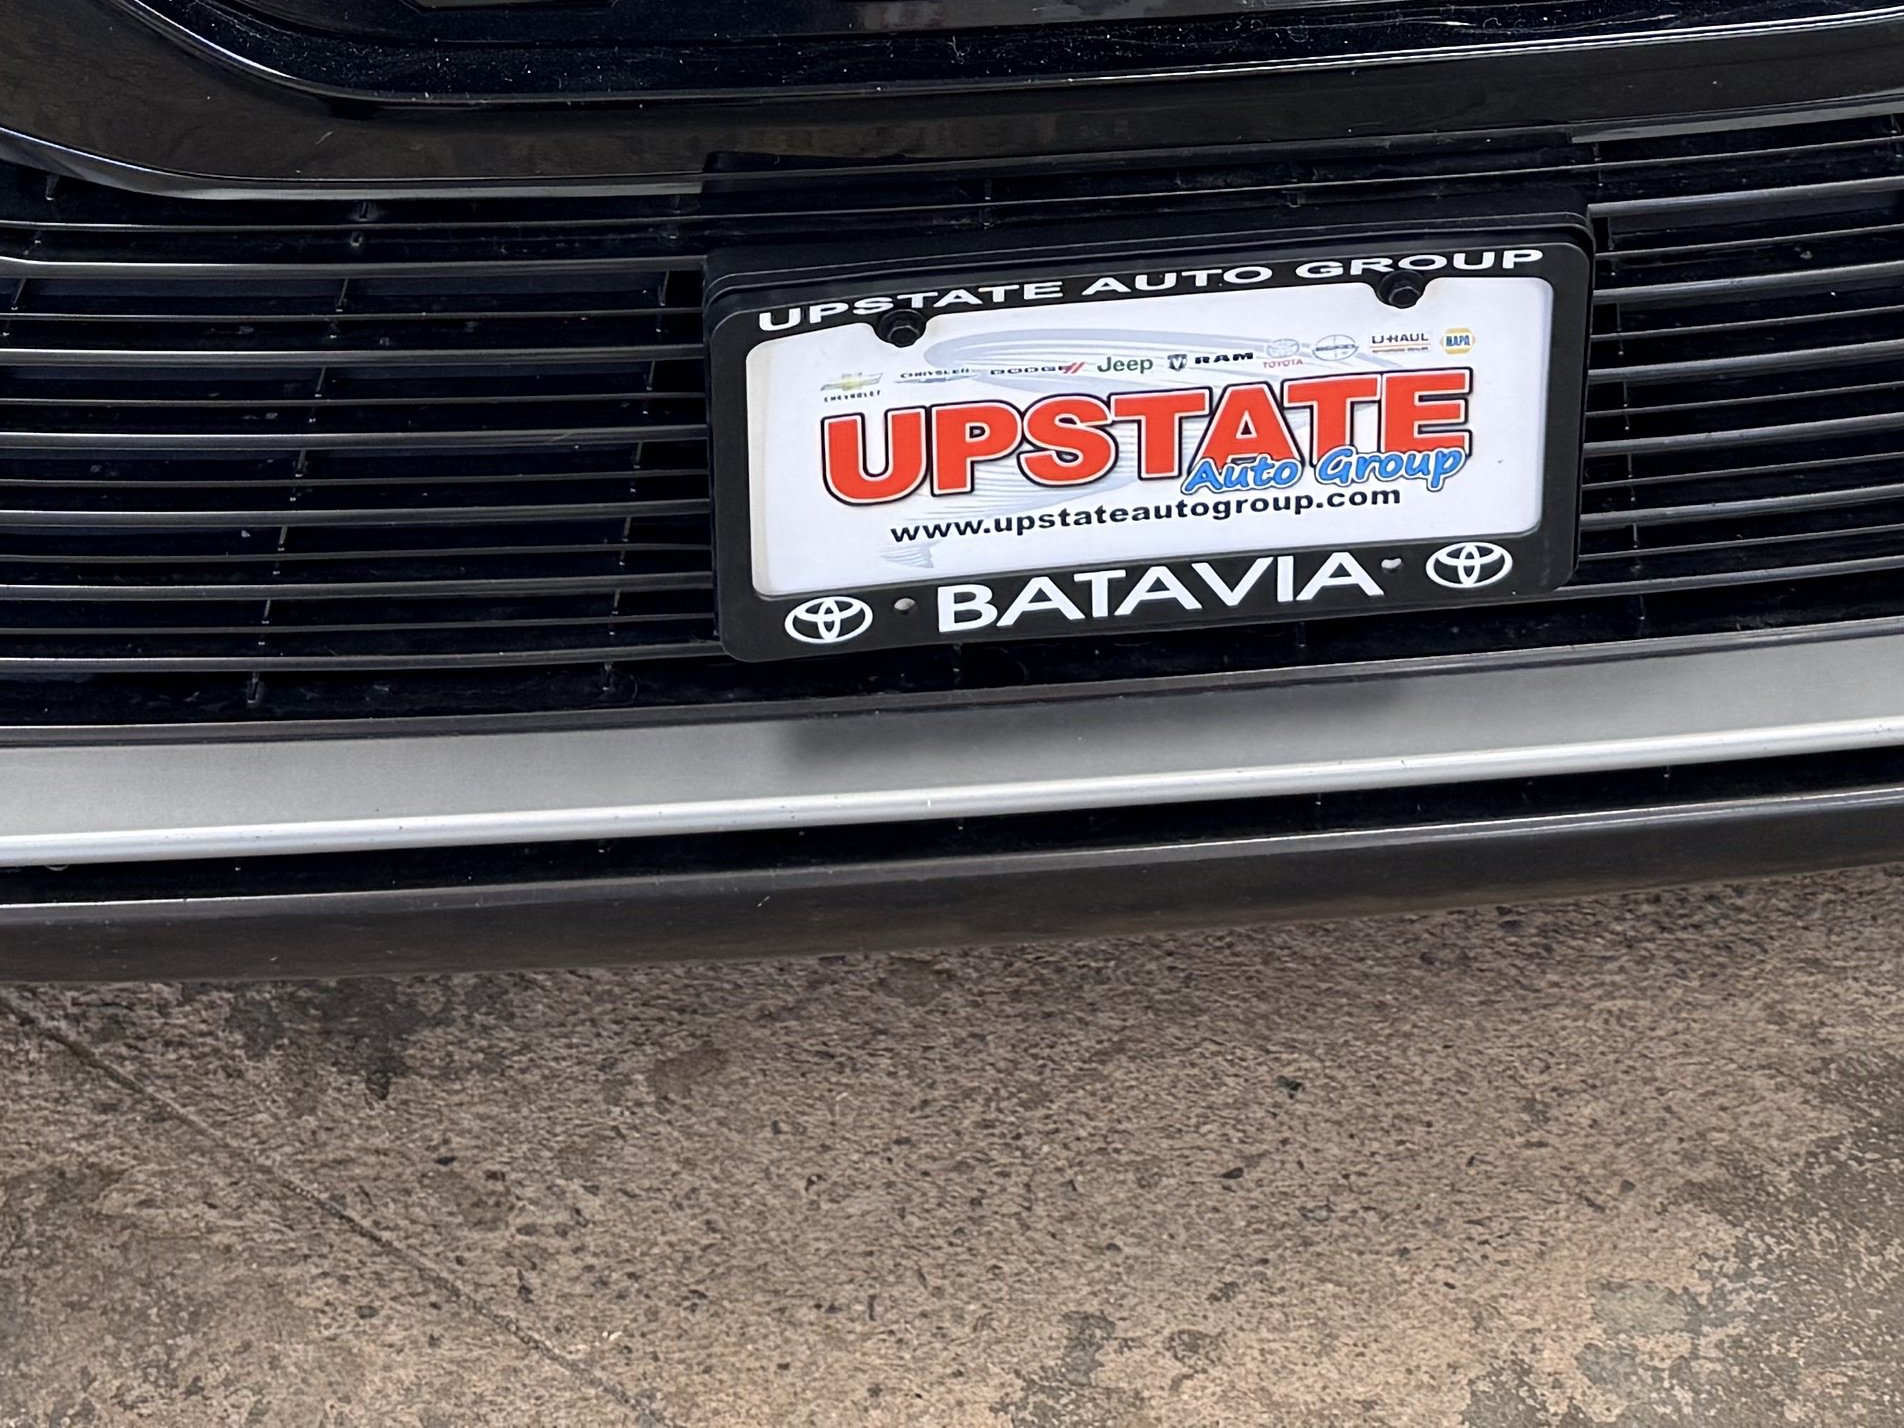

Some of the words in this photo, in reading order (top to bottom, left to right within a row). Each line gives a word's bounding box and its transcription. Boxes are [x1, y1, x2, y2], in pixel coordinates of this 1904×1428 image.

[758, 280, 1064, 332] UPSTATE
[1081, 265, 1274, 296] AUTO
[1295, 248, 1544, 279] GROUP
[1445, 334, 1471, 347] NAPA
[989, 365, 1068, 375] DODGE
[1096, 356, 1154, 375] Jeep
[1194, 352, 1254, 365] RAM
[1262, 358, 1304, 368] TOYOTA
[820, 367, 1475, 508] UPSTATE
[1181, 454, 1303, 494] Auto
[1315, 446, 1468, 494] Group
[891, 488, 1401, 544] www.upstateautogroup.com
[937, 550, 1385, 634] BATAVIA
